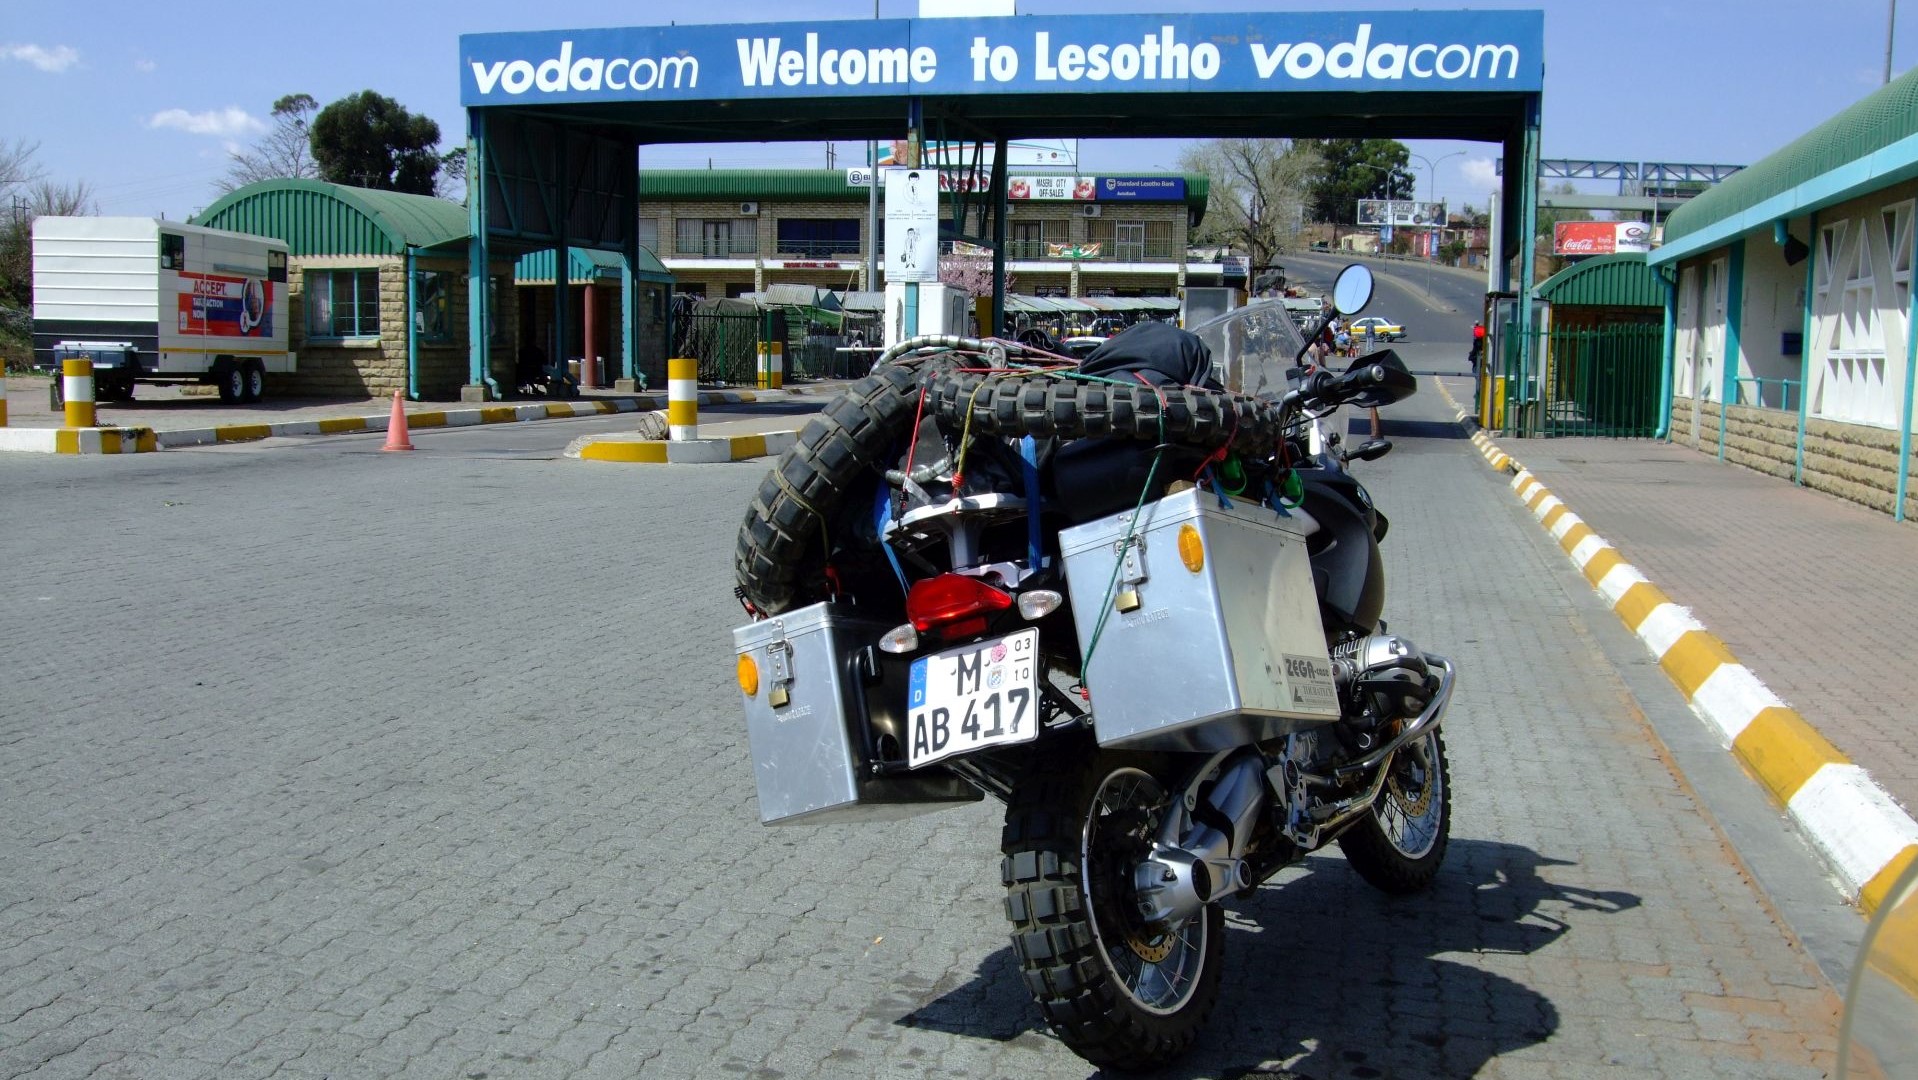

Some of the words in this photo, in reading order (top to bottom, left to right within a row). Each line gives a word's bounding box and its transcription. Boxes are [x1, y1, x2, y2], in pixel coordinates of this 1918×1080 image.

[471, 41, 699, 94] vodacom
[737, 32, 937, 86] Welcome
[971, 36, 1018, 83] to
[1035, 25, 1221, 82] Lesotho
[1250, 23, 1520, 80] vodacom
[1056, 178, 1067, 188] CITY
[1014, 638, 1031, 653] 03
[914, 690, 922, 703] D
[956, 649, 981, 697] M
[1014, 666, 1030, 681] 10
[913, 706, 950, 760] AB
[961, 687, 1030, 742] 417
